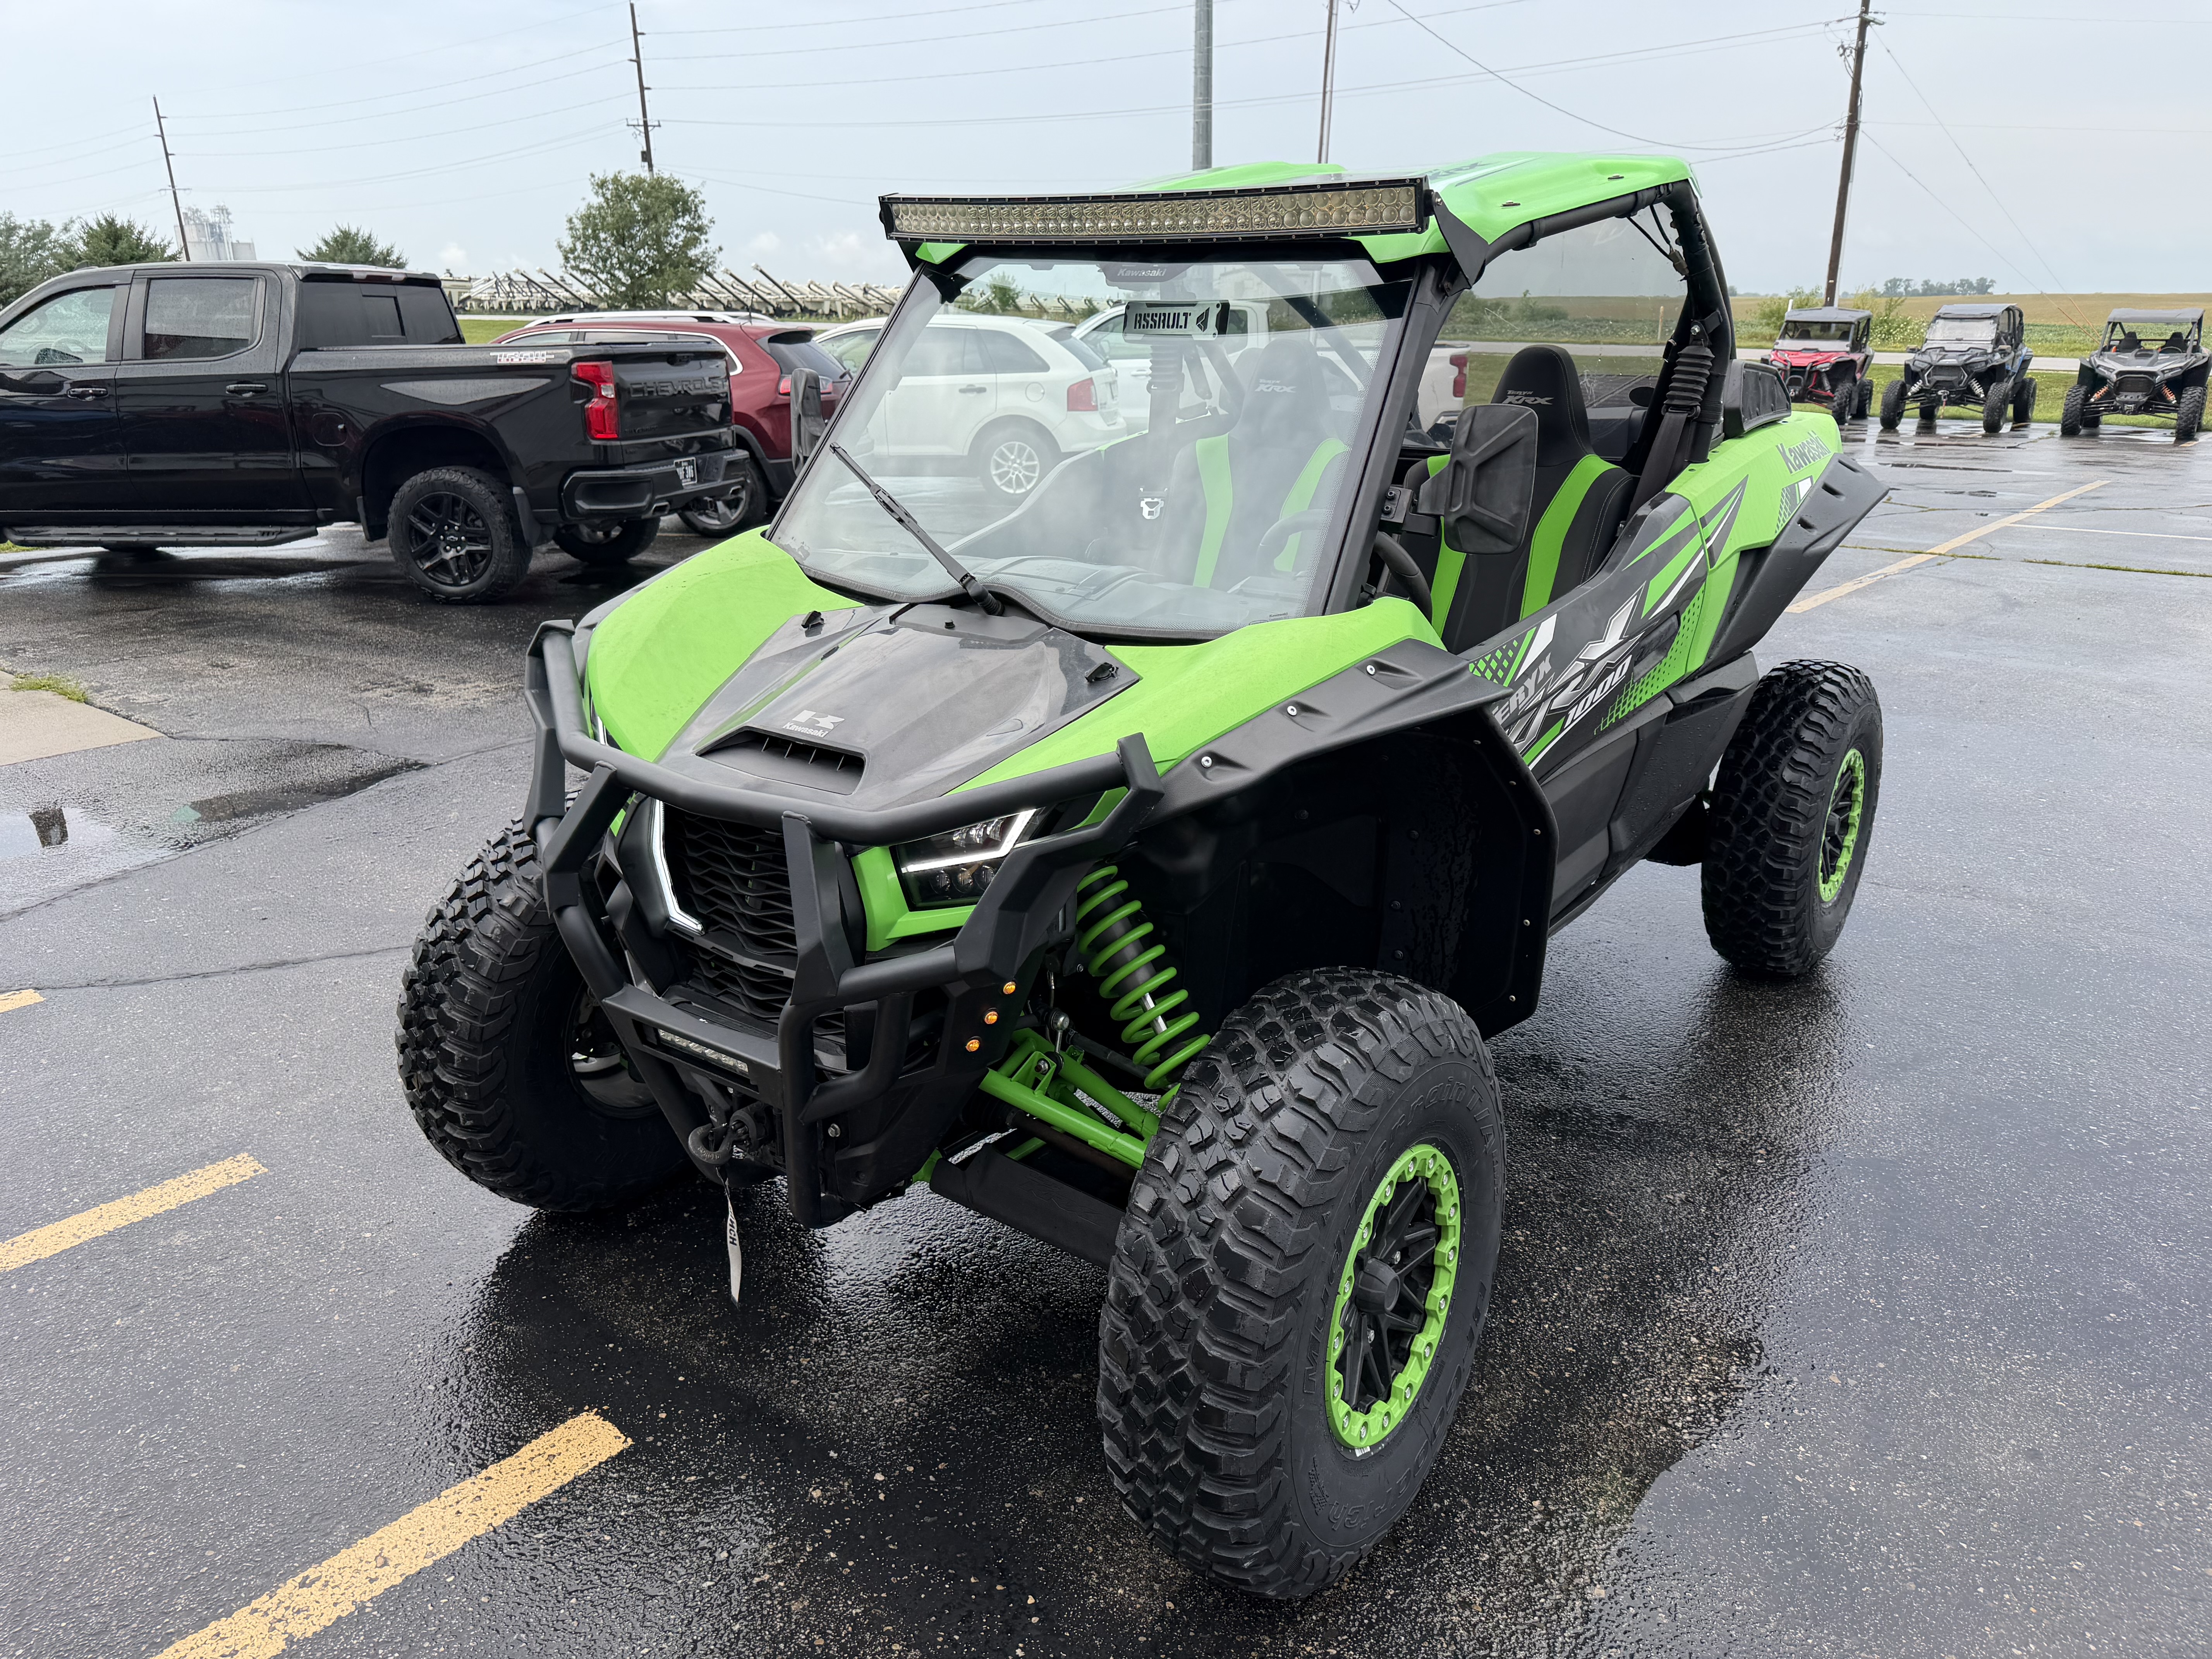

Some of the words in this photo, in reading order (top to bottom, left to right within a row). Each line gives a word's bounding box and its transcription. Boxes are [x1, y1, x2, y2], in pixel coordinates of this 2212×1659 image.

[1117, 268, 1167, 276] Kawasaki
[1134, 312, 1192, 329] ASSAULT
[1255, 384, 1297, 393] KRX
[1502, 395, 1554, 405] KRX
[1776, 430, 1831, 474] Kawasaki
[1492, 652, 1552, 725] ERYX
[1564, 654, 1632, 728] 1000
[782, 722, 828, 738] Kawasaki
